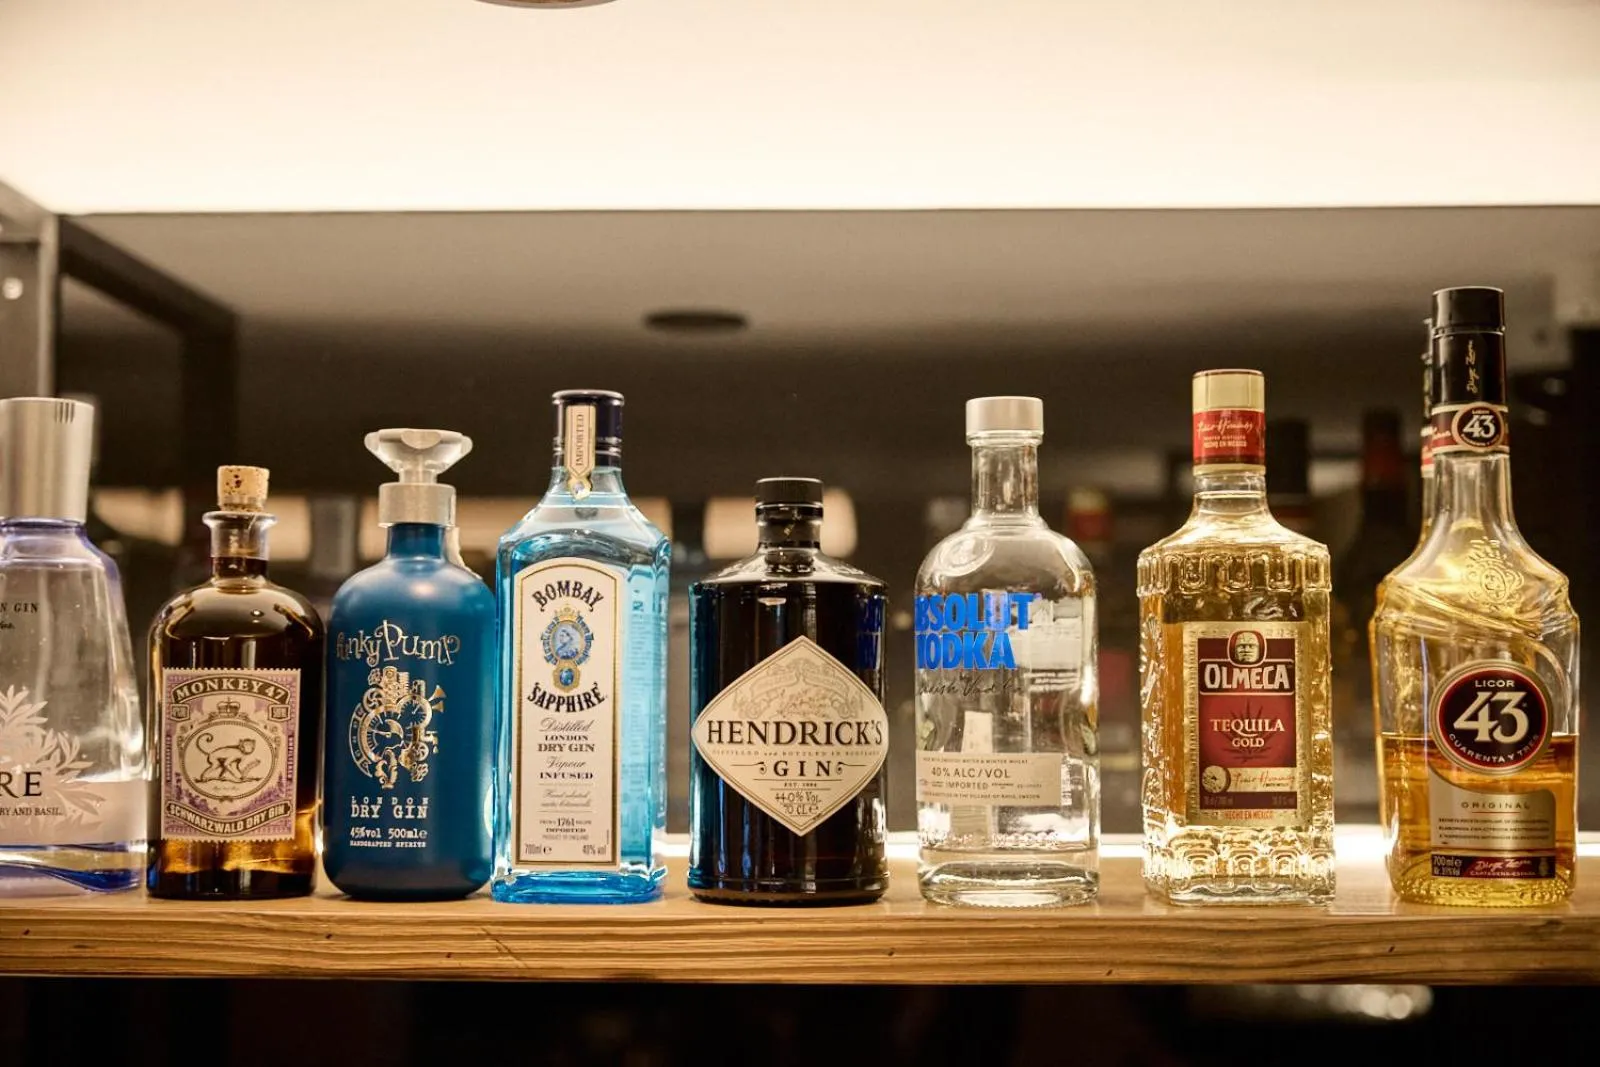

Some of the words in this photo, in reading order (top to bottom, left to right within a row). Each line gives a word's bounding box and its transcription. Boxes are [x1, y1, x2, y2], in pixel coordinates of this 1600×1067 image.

[1462, 414, 1496, 438] 43
[575, 414, 584, 467] IMPORTED
[532, 580, 604, 612] BOMBAY
[14, 602, 39, 613] GIN
[1204, 664, 1290, 689] OLMECA
[177, 678, 264, 700] MONKEY
[265, 685, 286, 700] 47
[527, 681, 606, 713] SAPPHIRE
[539, 718, 595, 732] Distilled
[1453, 691, 1529, 744] 43
[707, 720, 882, 745] HENDRICK'S
[1210, 718, 1285, 737] TEQUILA
[537, 744, 565, 752] DRY
[568, 744, 595, 752] GIN
[1231, 738, 1265, 748] GOLD
[1449, 733, 1505, 763] CUARENTA
[773, 760, 831, 777] GIN
[931, 767, 950, 777] 40%
[954, 768, 1011, 779] ALC/VOL
[946, 781, 988, 790] IMPORTED
[351, 796, 429, 804] LONDON
[13, 807, 32, 816] AND
[169, 804, 245, 833] SCHWARZWALD
[246, 812, 266, 828] DRY
[268, 803, 286, 819] GIN
[351, 805, 381, 819] DRY
[393, 805, 428, 819] GIN
